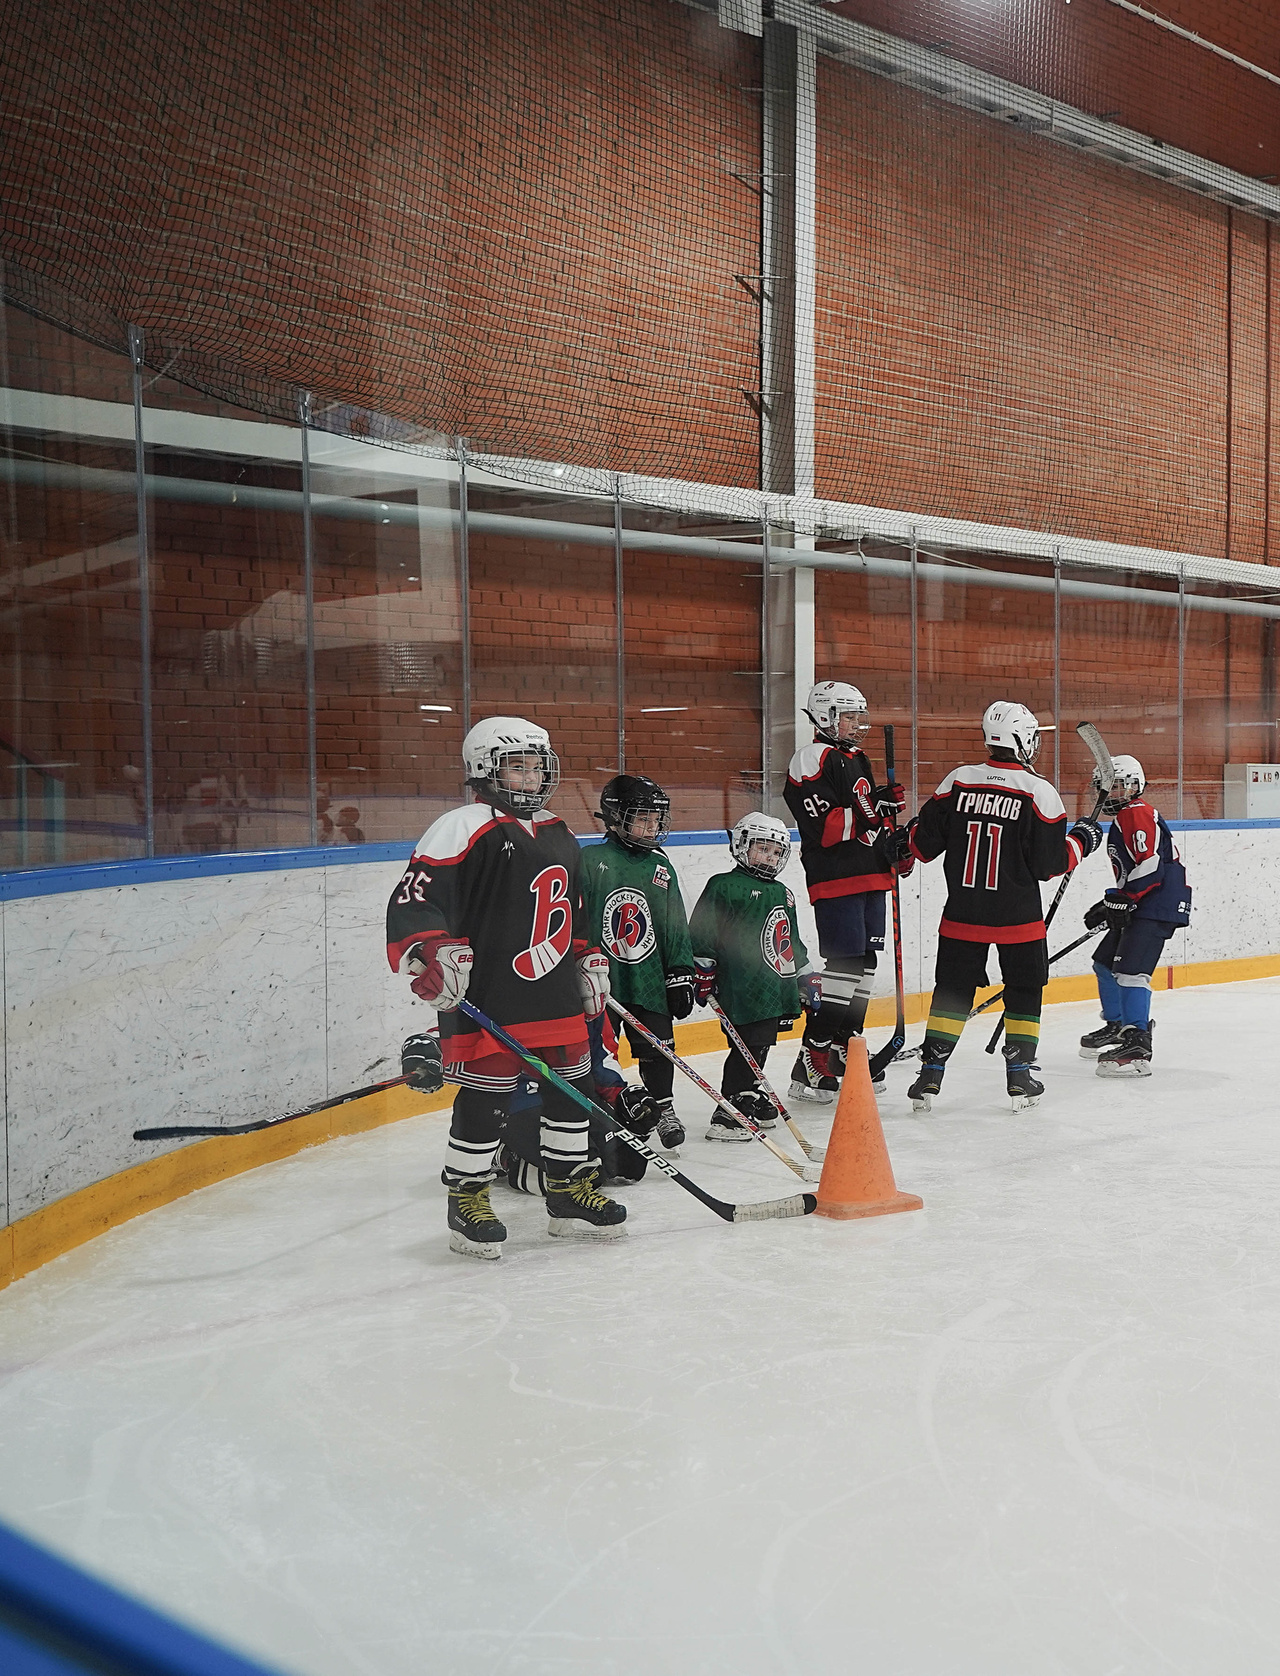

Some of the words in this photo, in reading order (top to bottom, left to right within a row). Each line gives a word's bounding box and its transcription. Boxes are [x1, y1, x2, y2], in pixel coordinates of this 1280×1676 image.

[803, 793, 831, 818] 95
[956, 791, 1023, 821] ГРИБКОВ
[962, 820, 1003, 891] 11
[398, 870, 432, 905] 35
[607, 893, 636, 912] HOCKEY
[603, 915, 613, 944] VIKHR
